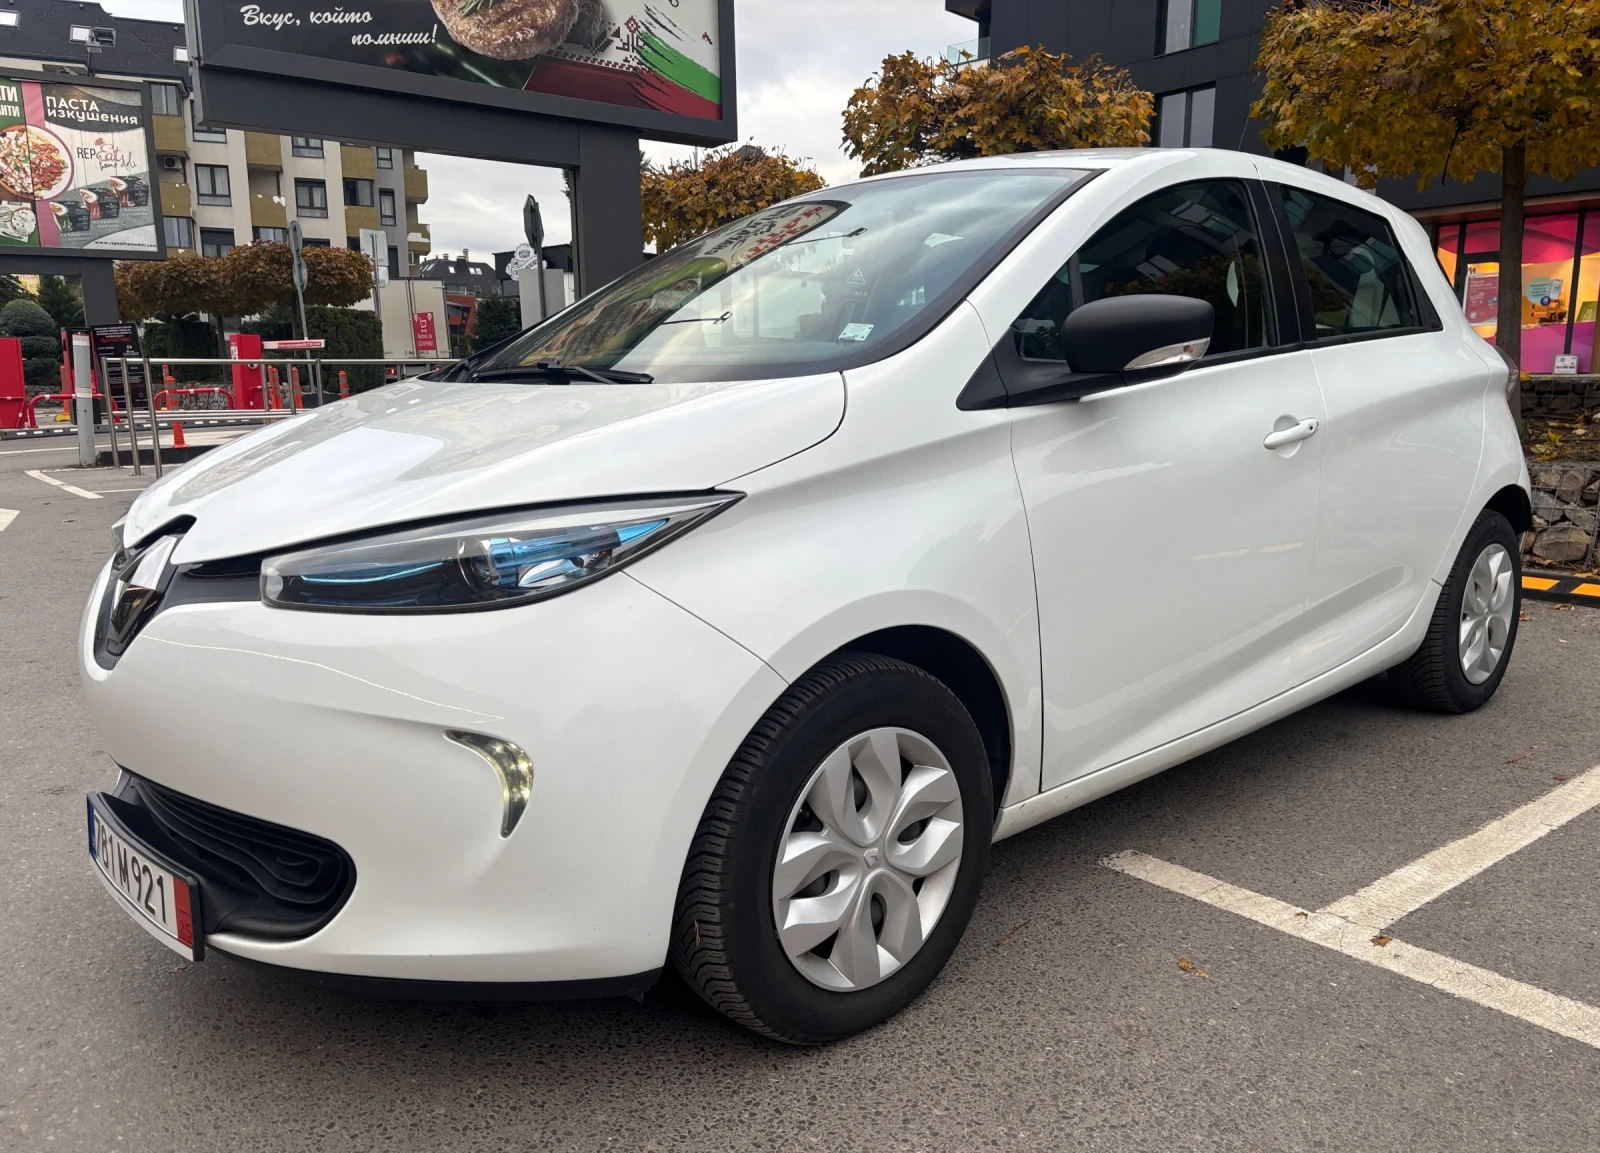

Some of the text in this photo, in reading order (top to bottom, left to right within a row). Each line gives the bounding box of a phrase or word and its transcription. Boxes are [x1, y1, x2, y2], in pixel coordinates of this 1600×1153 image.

[240, 4, 374, 31] Вкус, който
[351, 24, 438, 46] помниш!
[0, 85, 18, 102] ТИ
[45, 95, 100, 112] ПАСТА
[47, 107, 138, 125] изкушения
